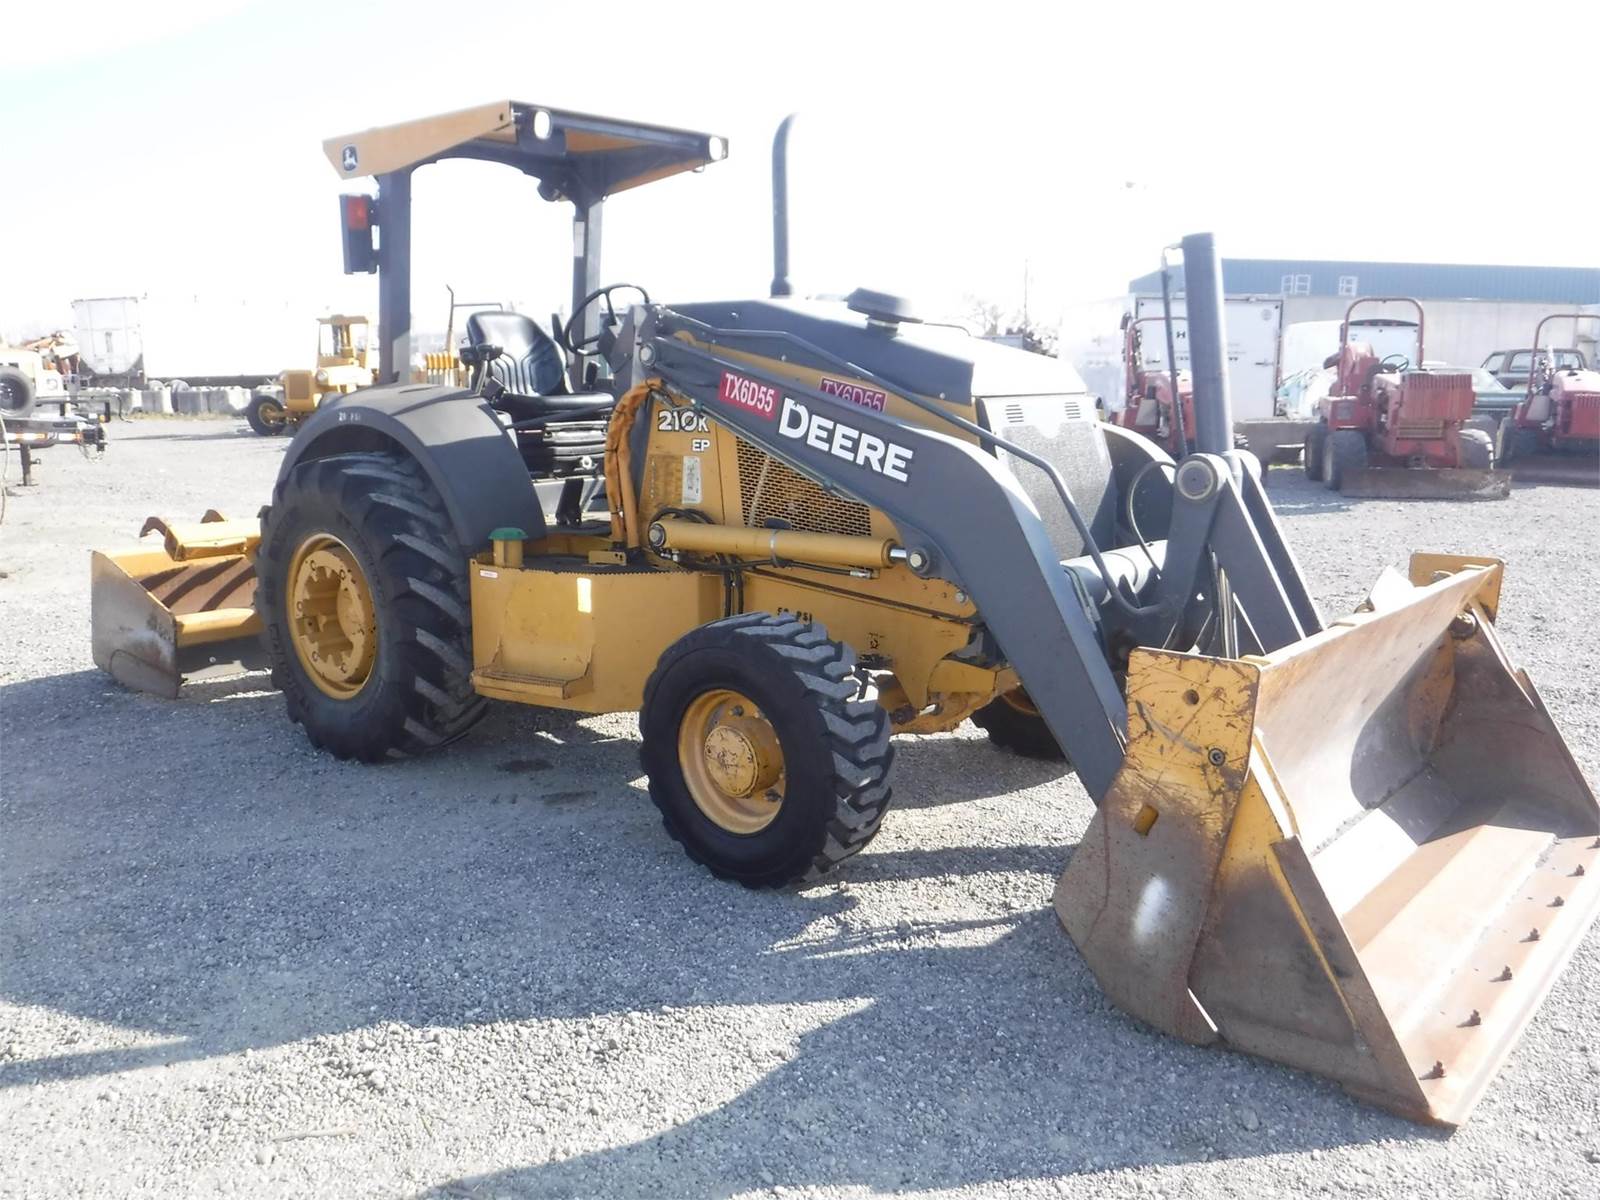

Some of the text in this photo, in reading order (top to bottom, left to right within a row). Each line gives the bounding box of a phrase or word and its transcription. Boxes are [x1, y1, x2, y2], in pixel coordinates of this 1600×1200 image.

[725, 373, 775, 413] TX6D55
[658, 410, 710, 432] 210K
[692, 439, 710, 452] EP
[778, 397, 914, 483] DEERE
